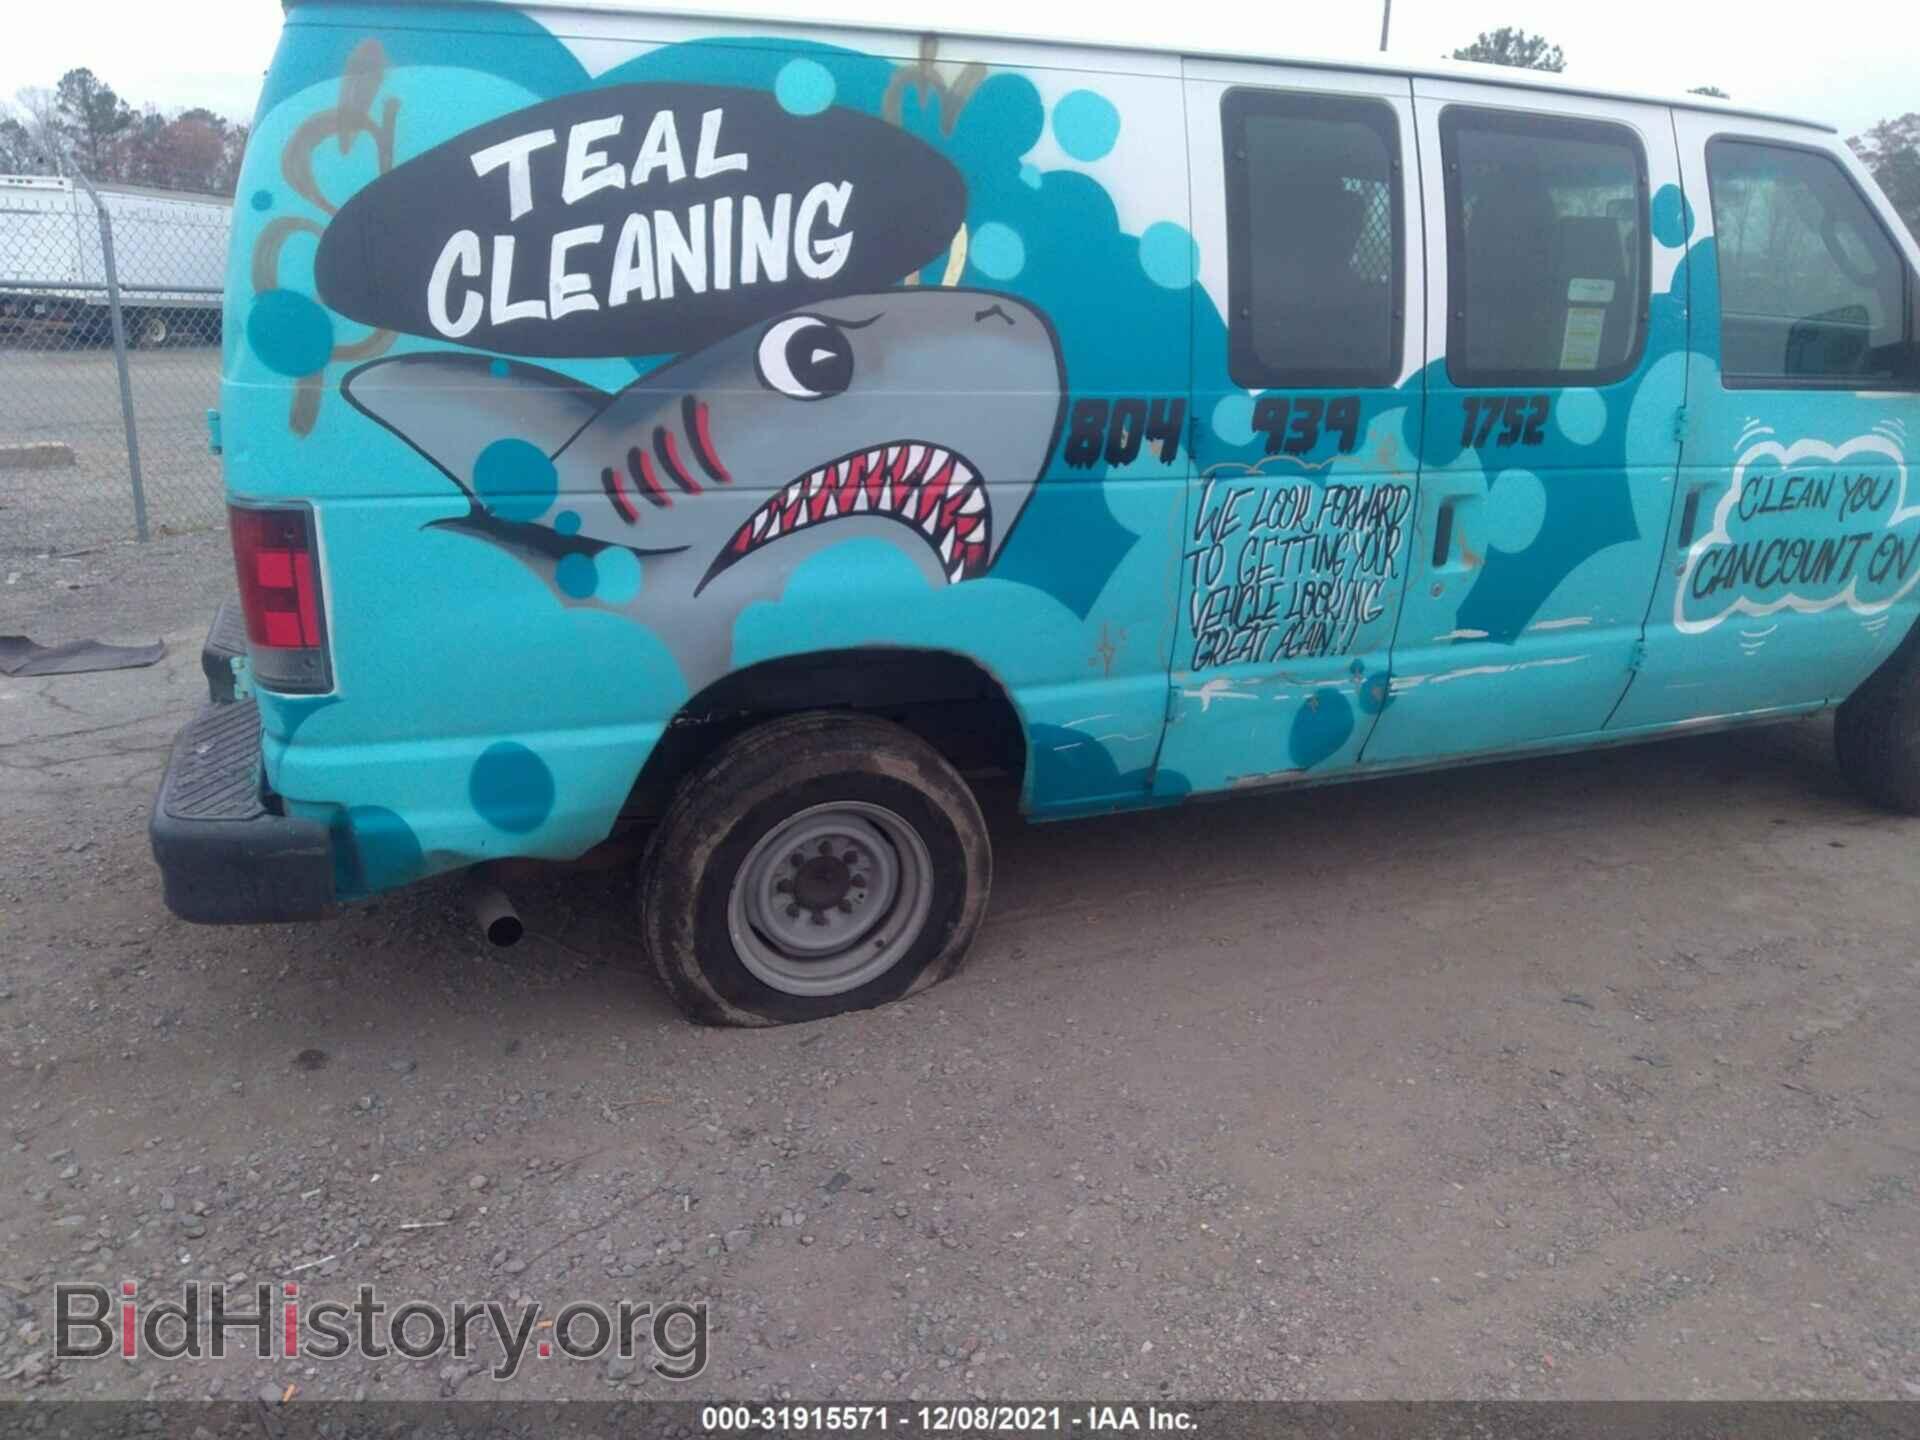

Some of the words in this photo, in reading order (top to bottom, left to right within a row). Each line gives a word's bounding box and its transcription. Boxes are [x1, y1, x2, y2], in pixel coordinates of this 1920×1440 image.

[470, 108, 748, 221] TEAL
[427, 180, 854, 339] CLEANING
[1064, 397, 1186, 468] 804
[1252, 396, 1361, 455] 939
[1461, 396, 1552, 448] 1752
[1194, 474, 1255, 544] WE
[1248, 485, 1315, 533] LOOK
[1738, 474, 1836, 522] CLEAN
[1838, 474, 1894, 523] YOU
[1185, 543, 1225, 588] TO
[1238, 531, 1350, 587] GETTING
